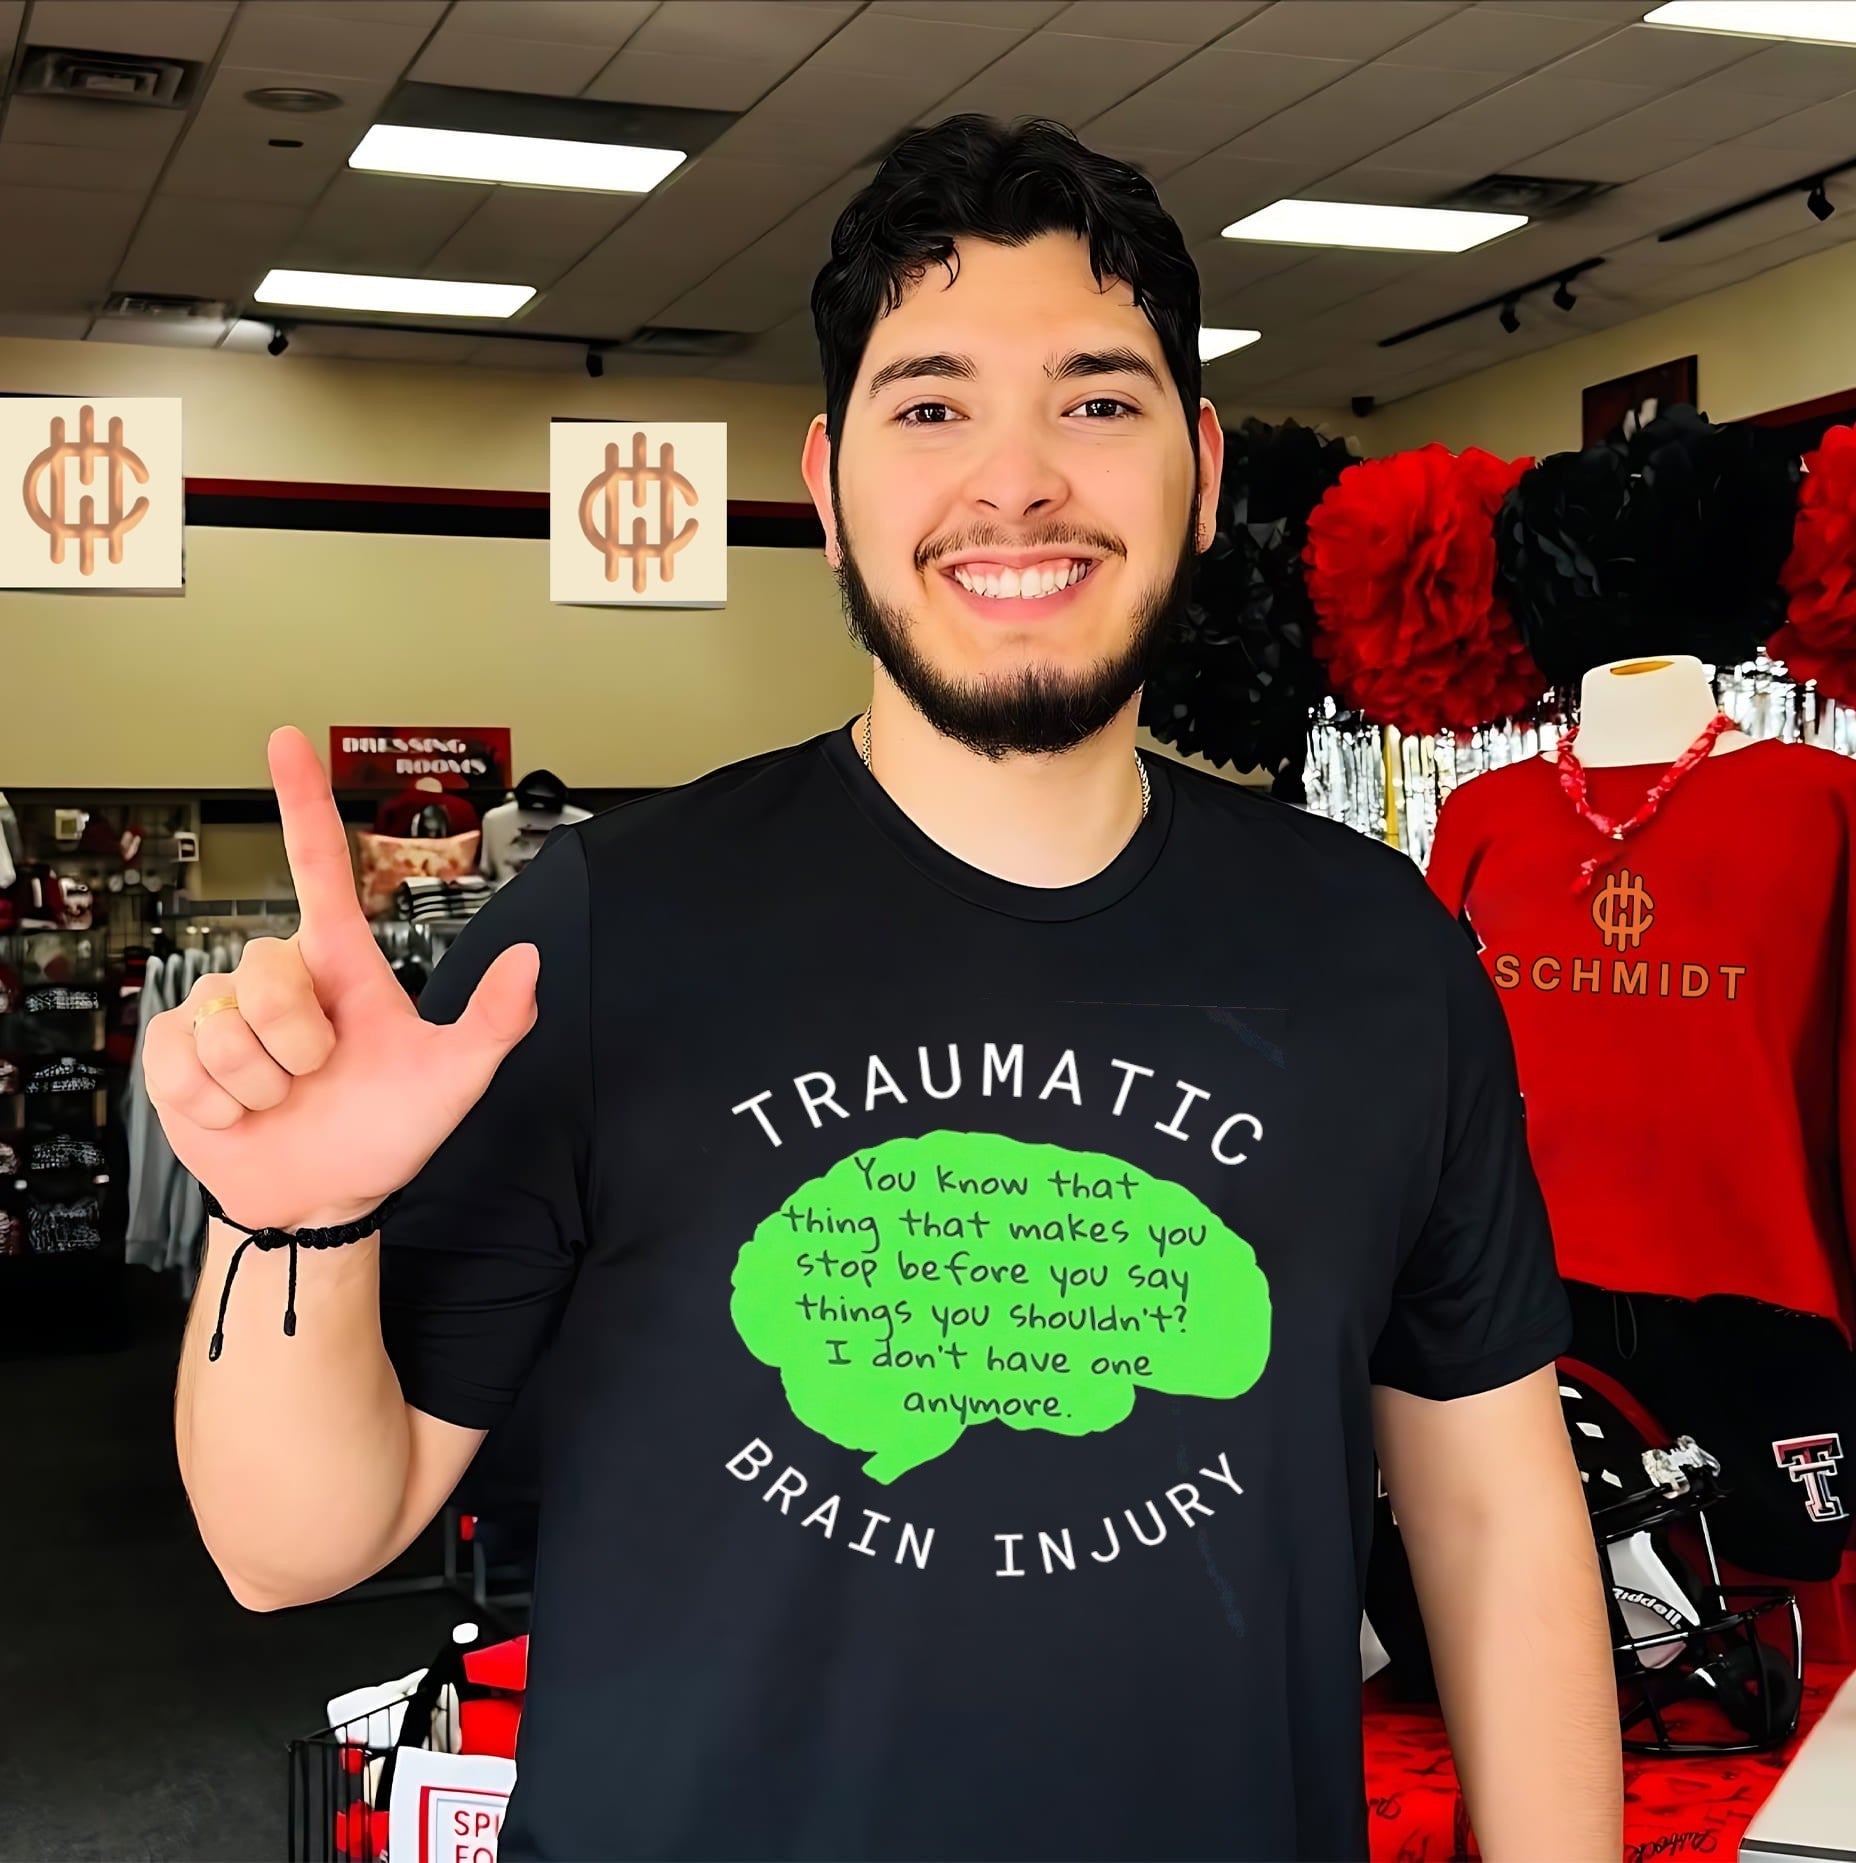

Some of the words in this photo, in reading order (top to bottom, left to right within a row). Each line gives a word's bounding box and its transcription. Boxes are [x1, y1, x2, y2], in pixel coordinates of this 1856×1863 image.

[342, 736, 467, 754] DRESSING
[396, 758, 487, 775] ROOMS
[1494, 953, 1747, 1000] SCHMIDT
[731, 1042, 1264, 1166] TRAUMATIC
[853, 1156, 916, 1193] You
[936, 1165, 1028, 1196] know
[1047, 1170, 1139, 1200] that
[781, 1205, 880, 1254] thing
[899, 1209, 990, 1239] that
[1009, 1213, 1129, 1243] makes
[1148, 1225, 1207, 1258] you
[796, 1249, 878, 1288] stop
[897, 1250, 1029, 1286] before
[1050, 1265, 1108, 1299] you
[1128, 1264, 1189, 1303] say
[795, 1293, 912, 1339] things
[931, 1305, 990, 1338] you
[1009, 1303, 1187, 1333] shouldn't?
[825, 1340, 852, 1365] I
[872, 1339, 968, 1371] don't
[987, 1345, 1071, 1374] have
[1091, 1355, 1153, 1376] one
[903, 1392, 1072, 1425] anymore.
[725, 1438, 935, 1569] BRAIN
[993, 1453, 1244, 1577] INJURY
